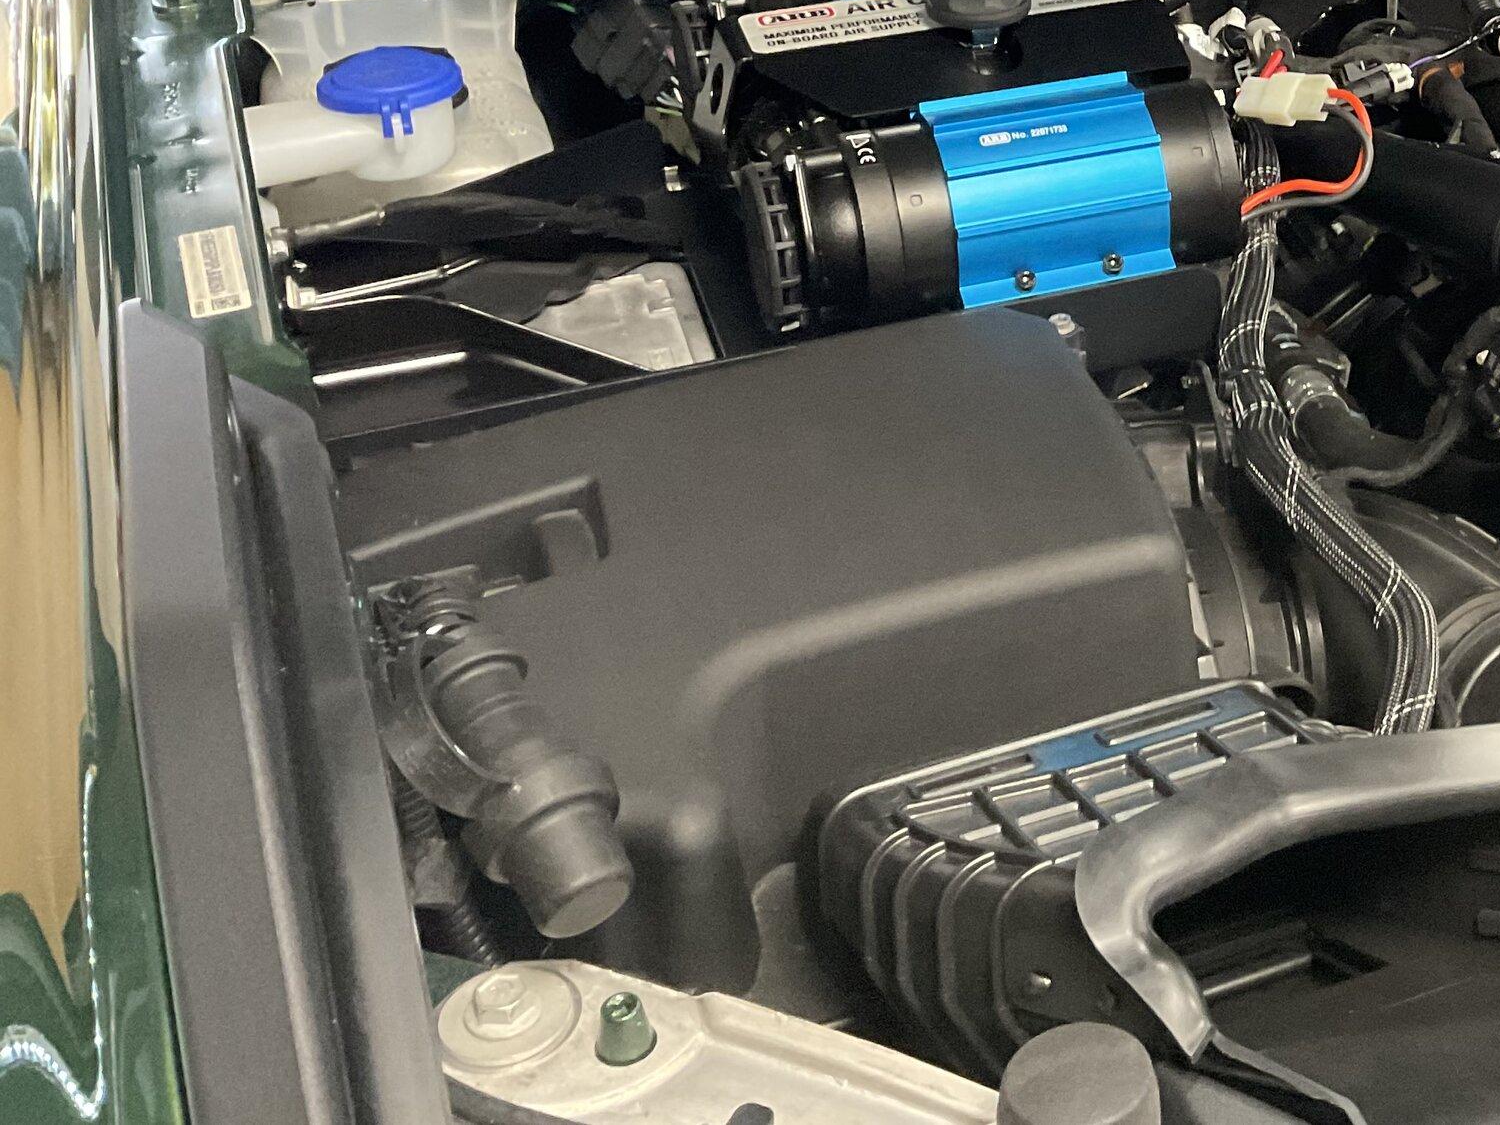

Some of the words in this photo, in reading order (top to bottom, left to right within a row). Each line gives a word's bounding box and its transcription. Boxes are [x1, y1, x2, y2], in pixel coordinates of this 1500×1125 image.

[764, 26, 827, 39] MAXIMUM
[830, 11, 921, 30] PERFORMANCE
[766, 7, 829, 25] ARB
[767, 31, 839, 47] ON-BOARD
[844, 26, 867, 36] AIR
[870, 19, 921, 33] SUPPLY
